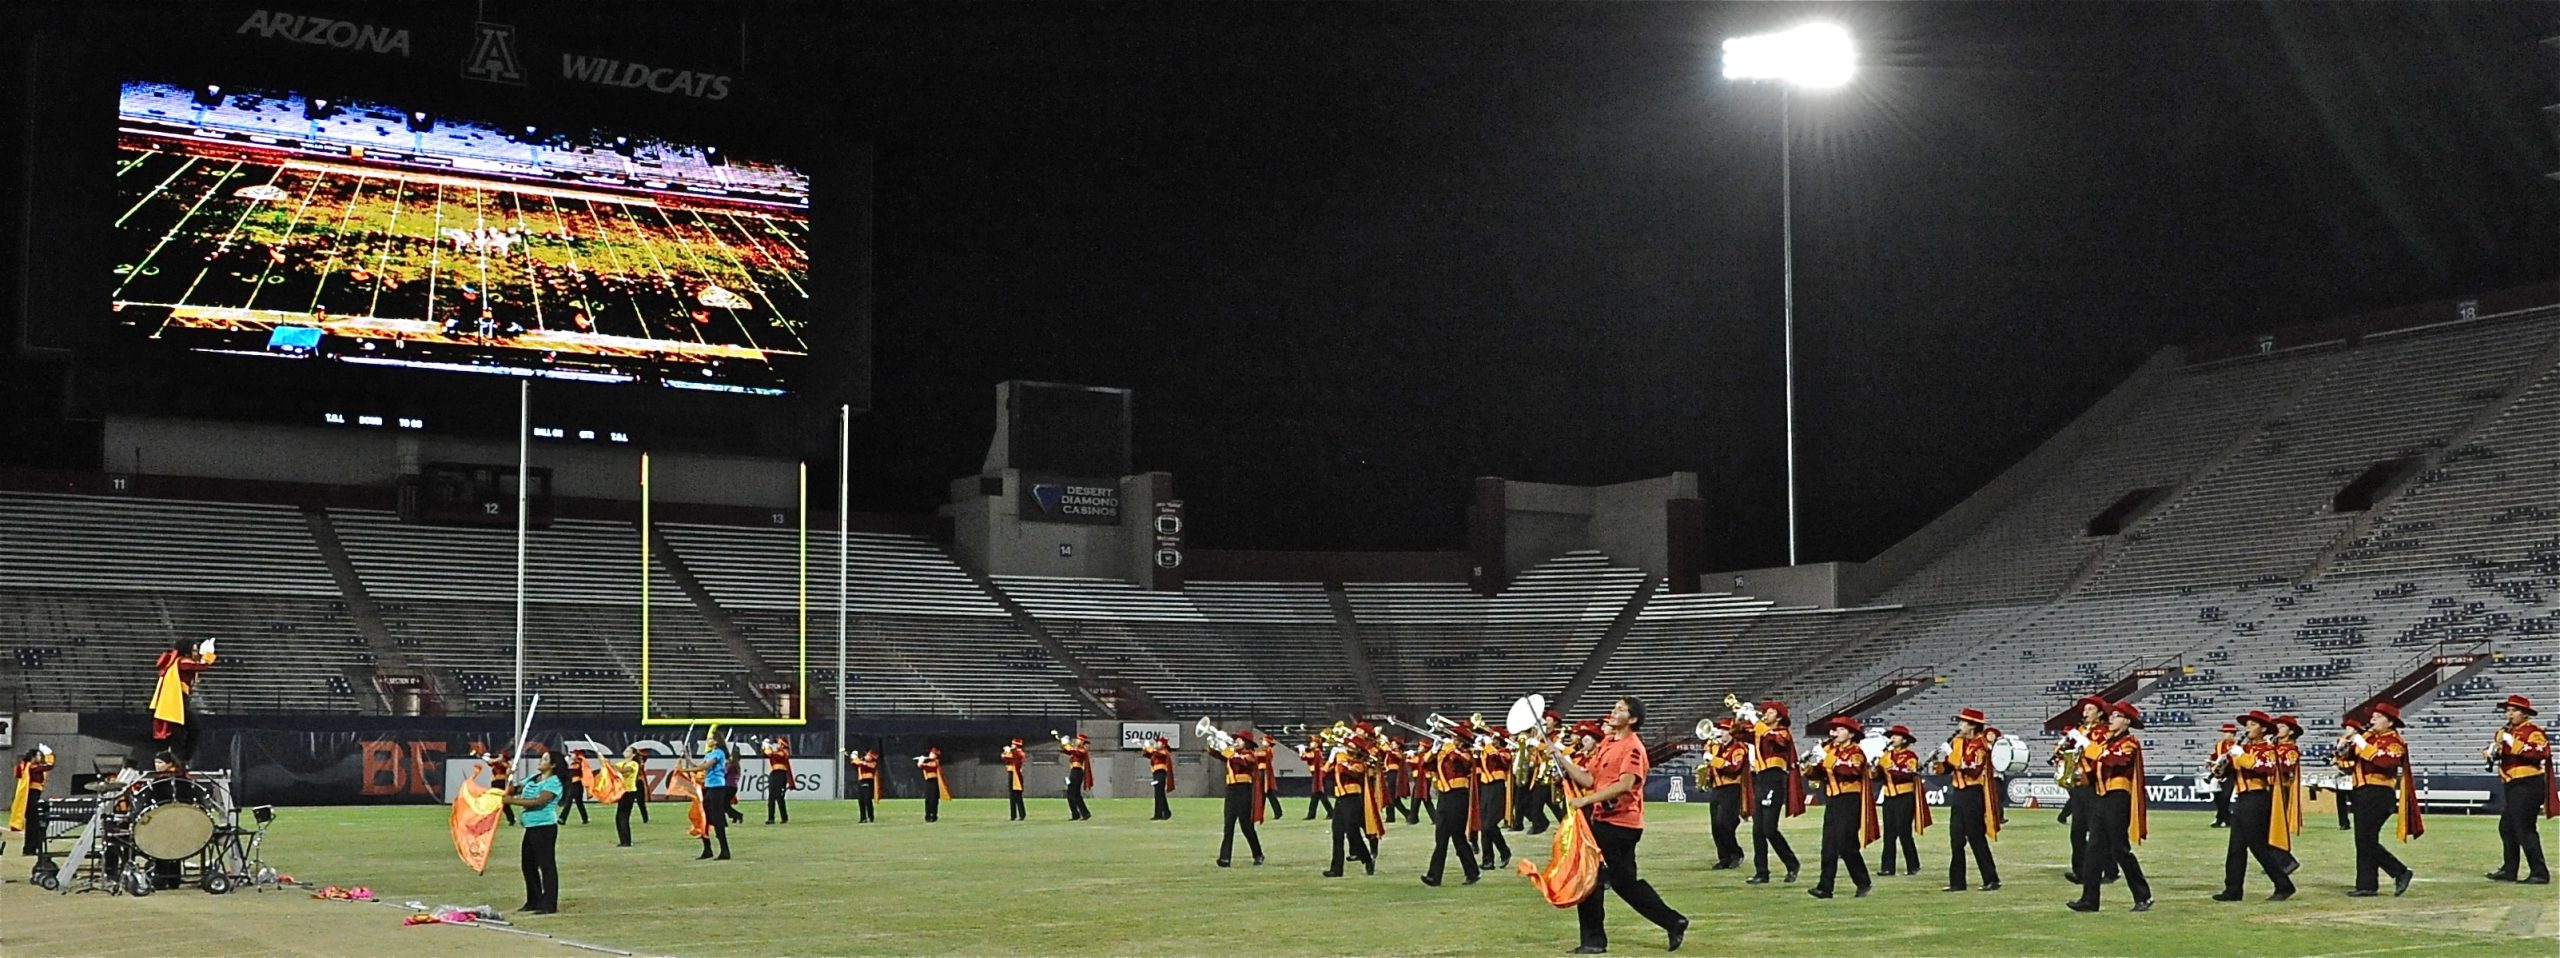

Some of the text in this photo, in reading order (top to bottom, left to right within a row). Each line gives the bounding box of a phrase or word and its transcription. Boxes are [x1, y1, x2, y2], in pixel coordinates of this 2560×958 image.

[236, 9, 411, 57] ARIZONA
[460, 21, 528, 86] A
[561, 52, 733, 101] WILDCATS
[2459, 307, 2476, 321] 18
[2260, 341, 2273, 353] 17
[113, 478, 125, 490] 11
[1067, 486, 1113, 497] DESERT
[1061, 495, 1119, 507] DIAMOND
[484, 503, 499, 515] 12
[1062, 506, 1117, 517] CASINOS
[772, 514, 784, 524] 13
[1060, 546, 1071, 555] 14
[1125, 730, 1160, 740] SOLON
[1668, 777, 1686, 802] A
